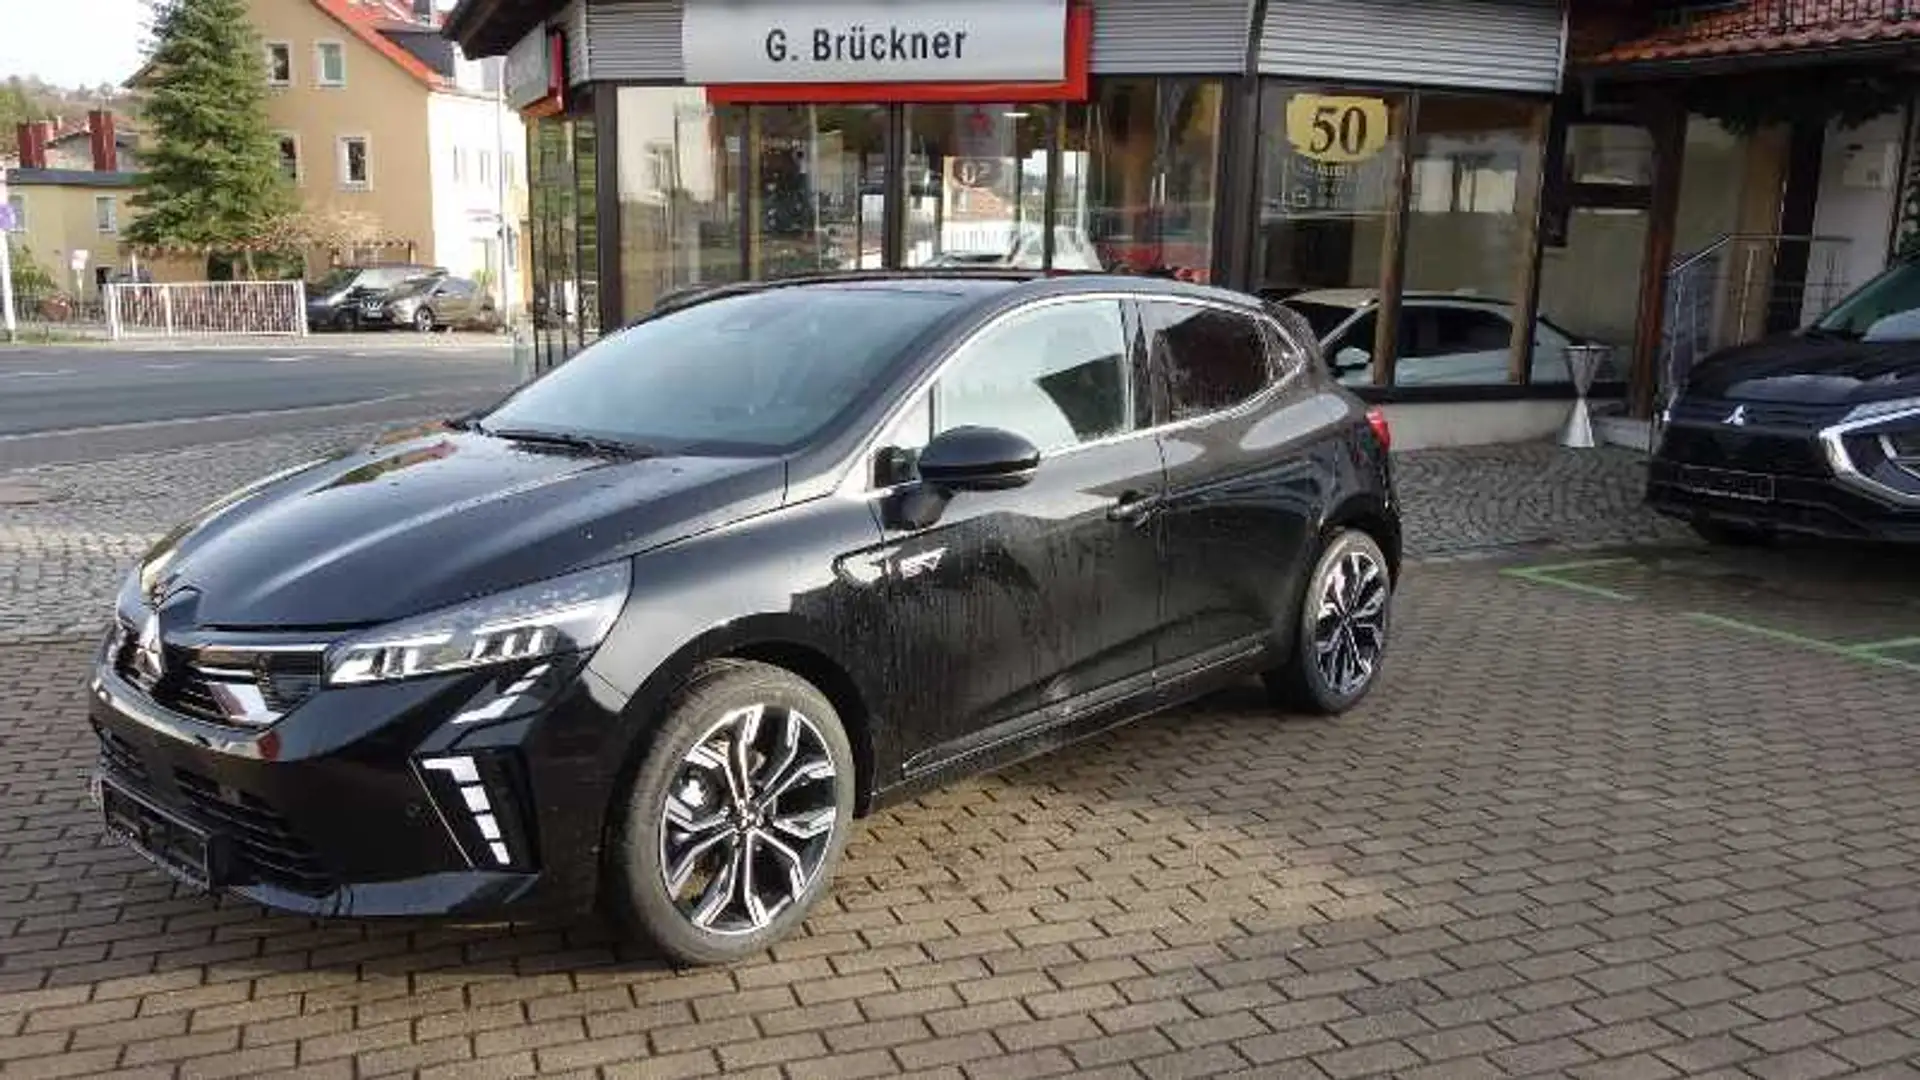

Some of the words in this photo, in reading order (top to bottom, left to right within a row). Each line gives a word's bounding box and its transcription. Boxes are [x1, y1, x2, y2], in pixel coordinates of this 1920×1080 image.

[766, 28, 798, 61] G.
[813, 26, 966, 61] Brückner
[1310, 106, 1367, 155] 50
